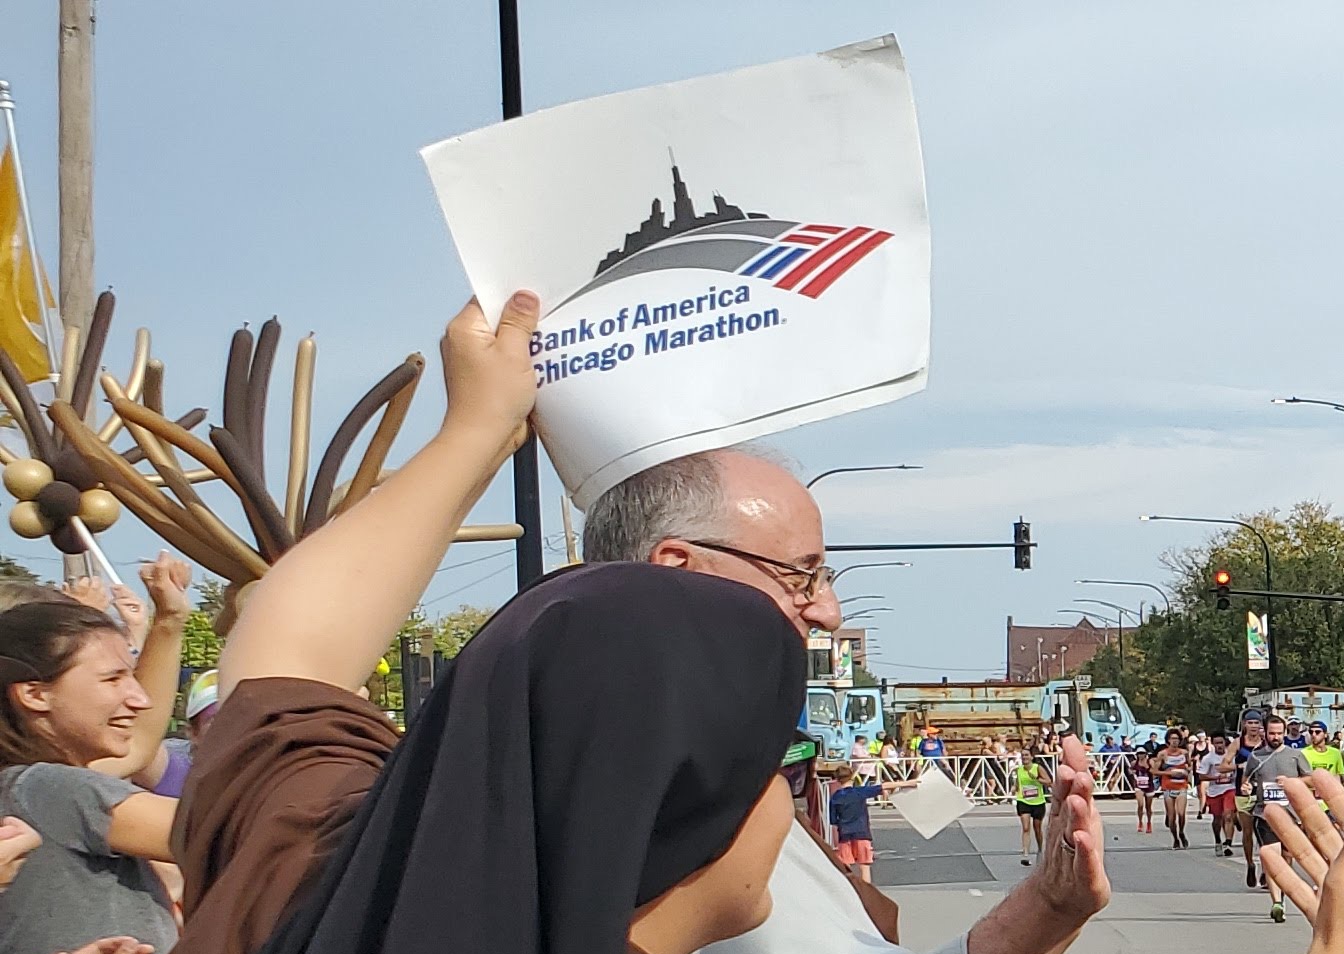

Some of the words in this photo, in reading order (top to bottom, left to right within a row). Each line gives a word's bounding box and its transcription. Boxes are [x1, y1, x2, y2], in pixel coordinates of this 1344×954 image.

[528, 318, 596, 357] Bank
[599, 307, 629, 338] of
[632, 284, 751, 331] America
[533, 341, 635, 389] Chicago
